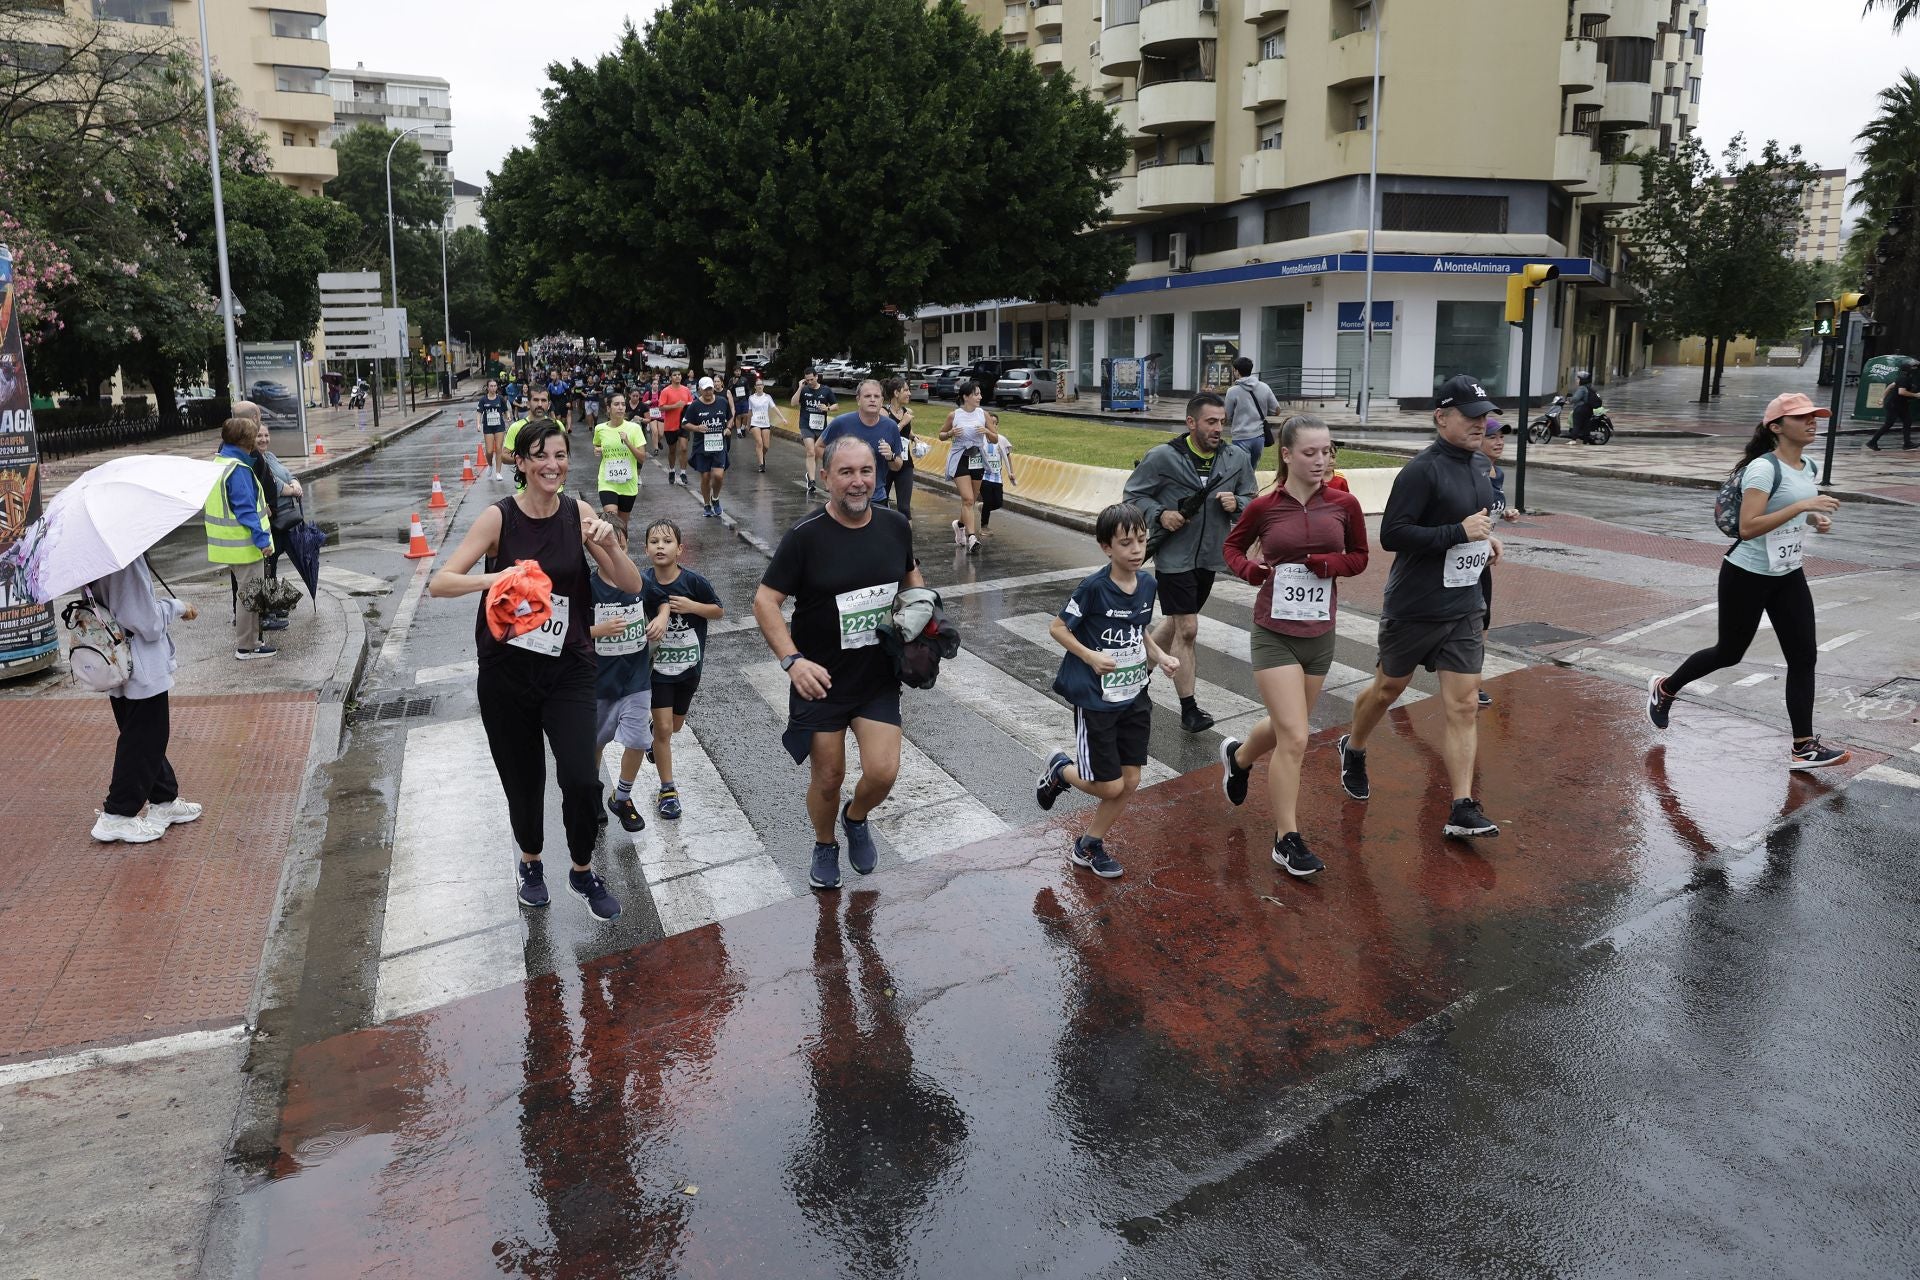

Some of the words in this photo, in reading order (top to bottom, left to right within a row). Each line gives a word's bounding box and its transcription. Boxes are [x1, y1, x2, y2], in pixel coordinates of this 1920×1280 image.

[1281, 263, 1321, 275] MonteAlminara
[1444, 261, 1510, 272] MonteAlminara
[1471, 384, 1487, 397] LA
[609, 469, 628, 477] 5342
[1456, 552, 1486, 570] 3906
[1284, 586, 1324, 602] 3912
[1106, 665, 1146, 688] 22326
